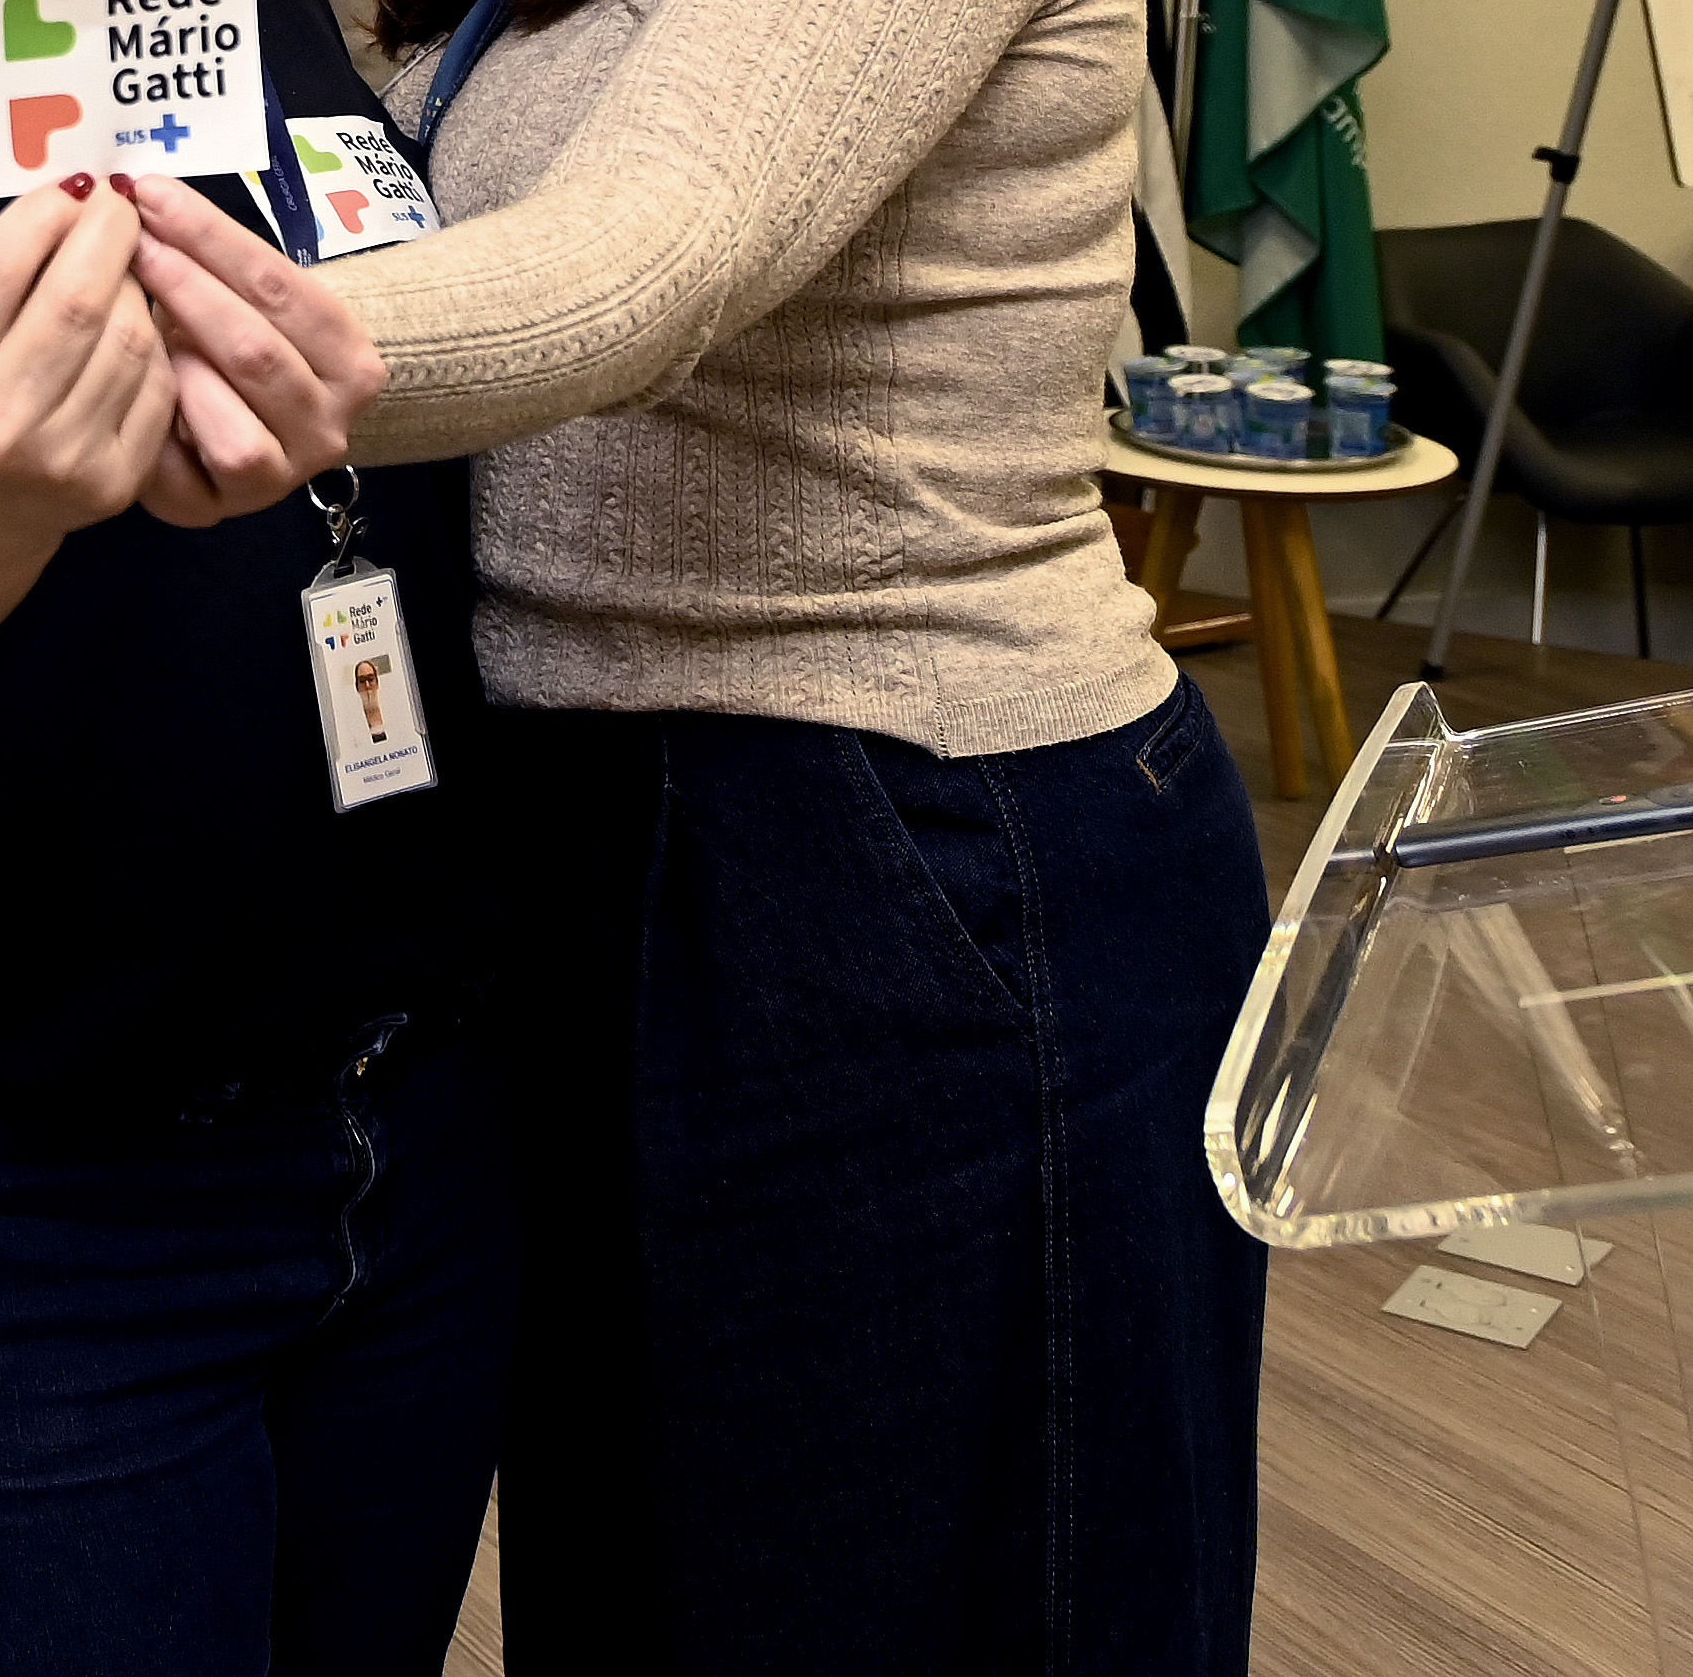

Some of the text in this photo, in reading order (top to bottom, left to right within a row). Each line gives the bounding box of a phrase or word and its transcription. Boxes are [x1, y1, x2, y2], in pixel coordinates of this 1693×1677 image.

[108, 14, 239, 64] Mário
[112, 56, 225, 105] Gatti
[114, 129, 146, 148] SUS
[335, 130, 394, 154] Rede
[354, 153, 414, 181] Mário
[372, 178, 425, 203] Gatti
